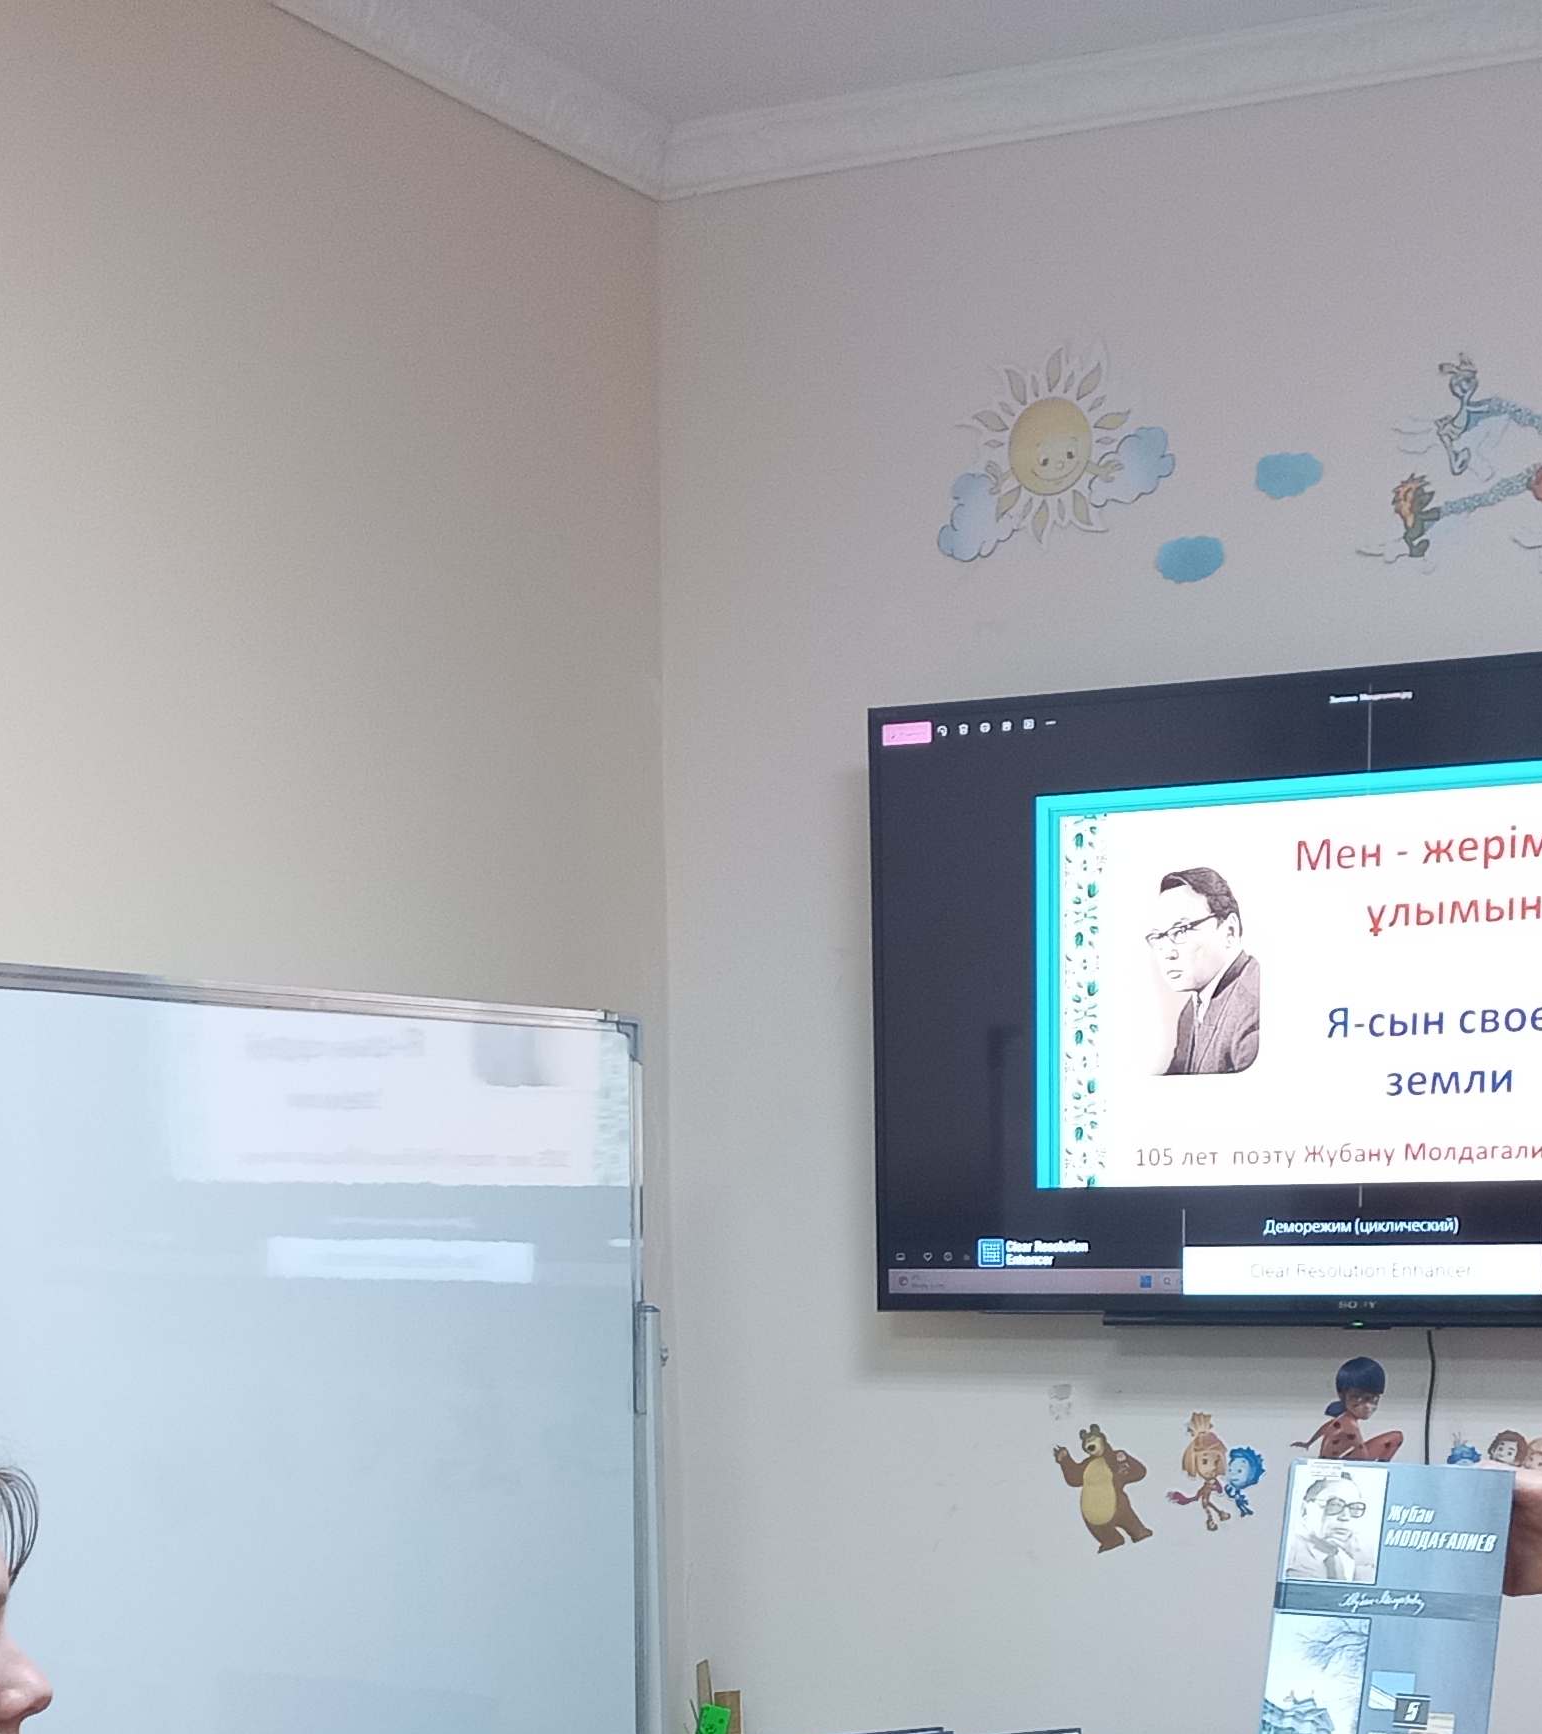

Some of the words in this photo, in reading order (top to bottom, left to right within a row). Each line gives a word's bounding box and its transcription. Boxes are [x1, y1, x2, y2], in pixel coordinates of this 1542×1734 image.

[1296, 838, 1382, 872] Мен
[1367, 895, 1542, 937] ұлымын
[1327, 1006, 1445, 1039] Я-сын
[1386, 1069, 1514, 1097] земли
[1136, 1148, 1173, 1168] 105
[1182, 1150, 1218, 1167] лет
[1233, 1149, 1295, 1169] поэту
[1304, 1143, 1395, 1169] Жубану
[1263, 1219, 1352, 1236] Деморежим
[1354, 1217, 1459, 1236] (циклический)
[1297, 1262, 1387, 1279] Resolution
[1404, 1701, 1422, 1722] 5
